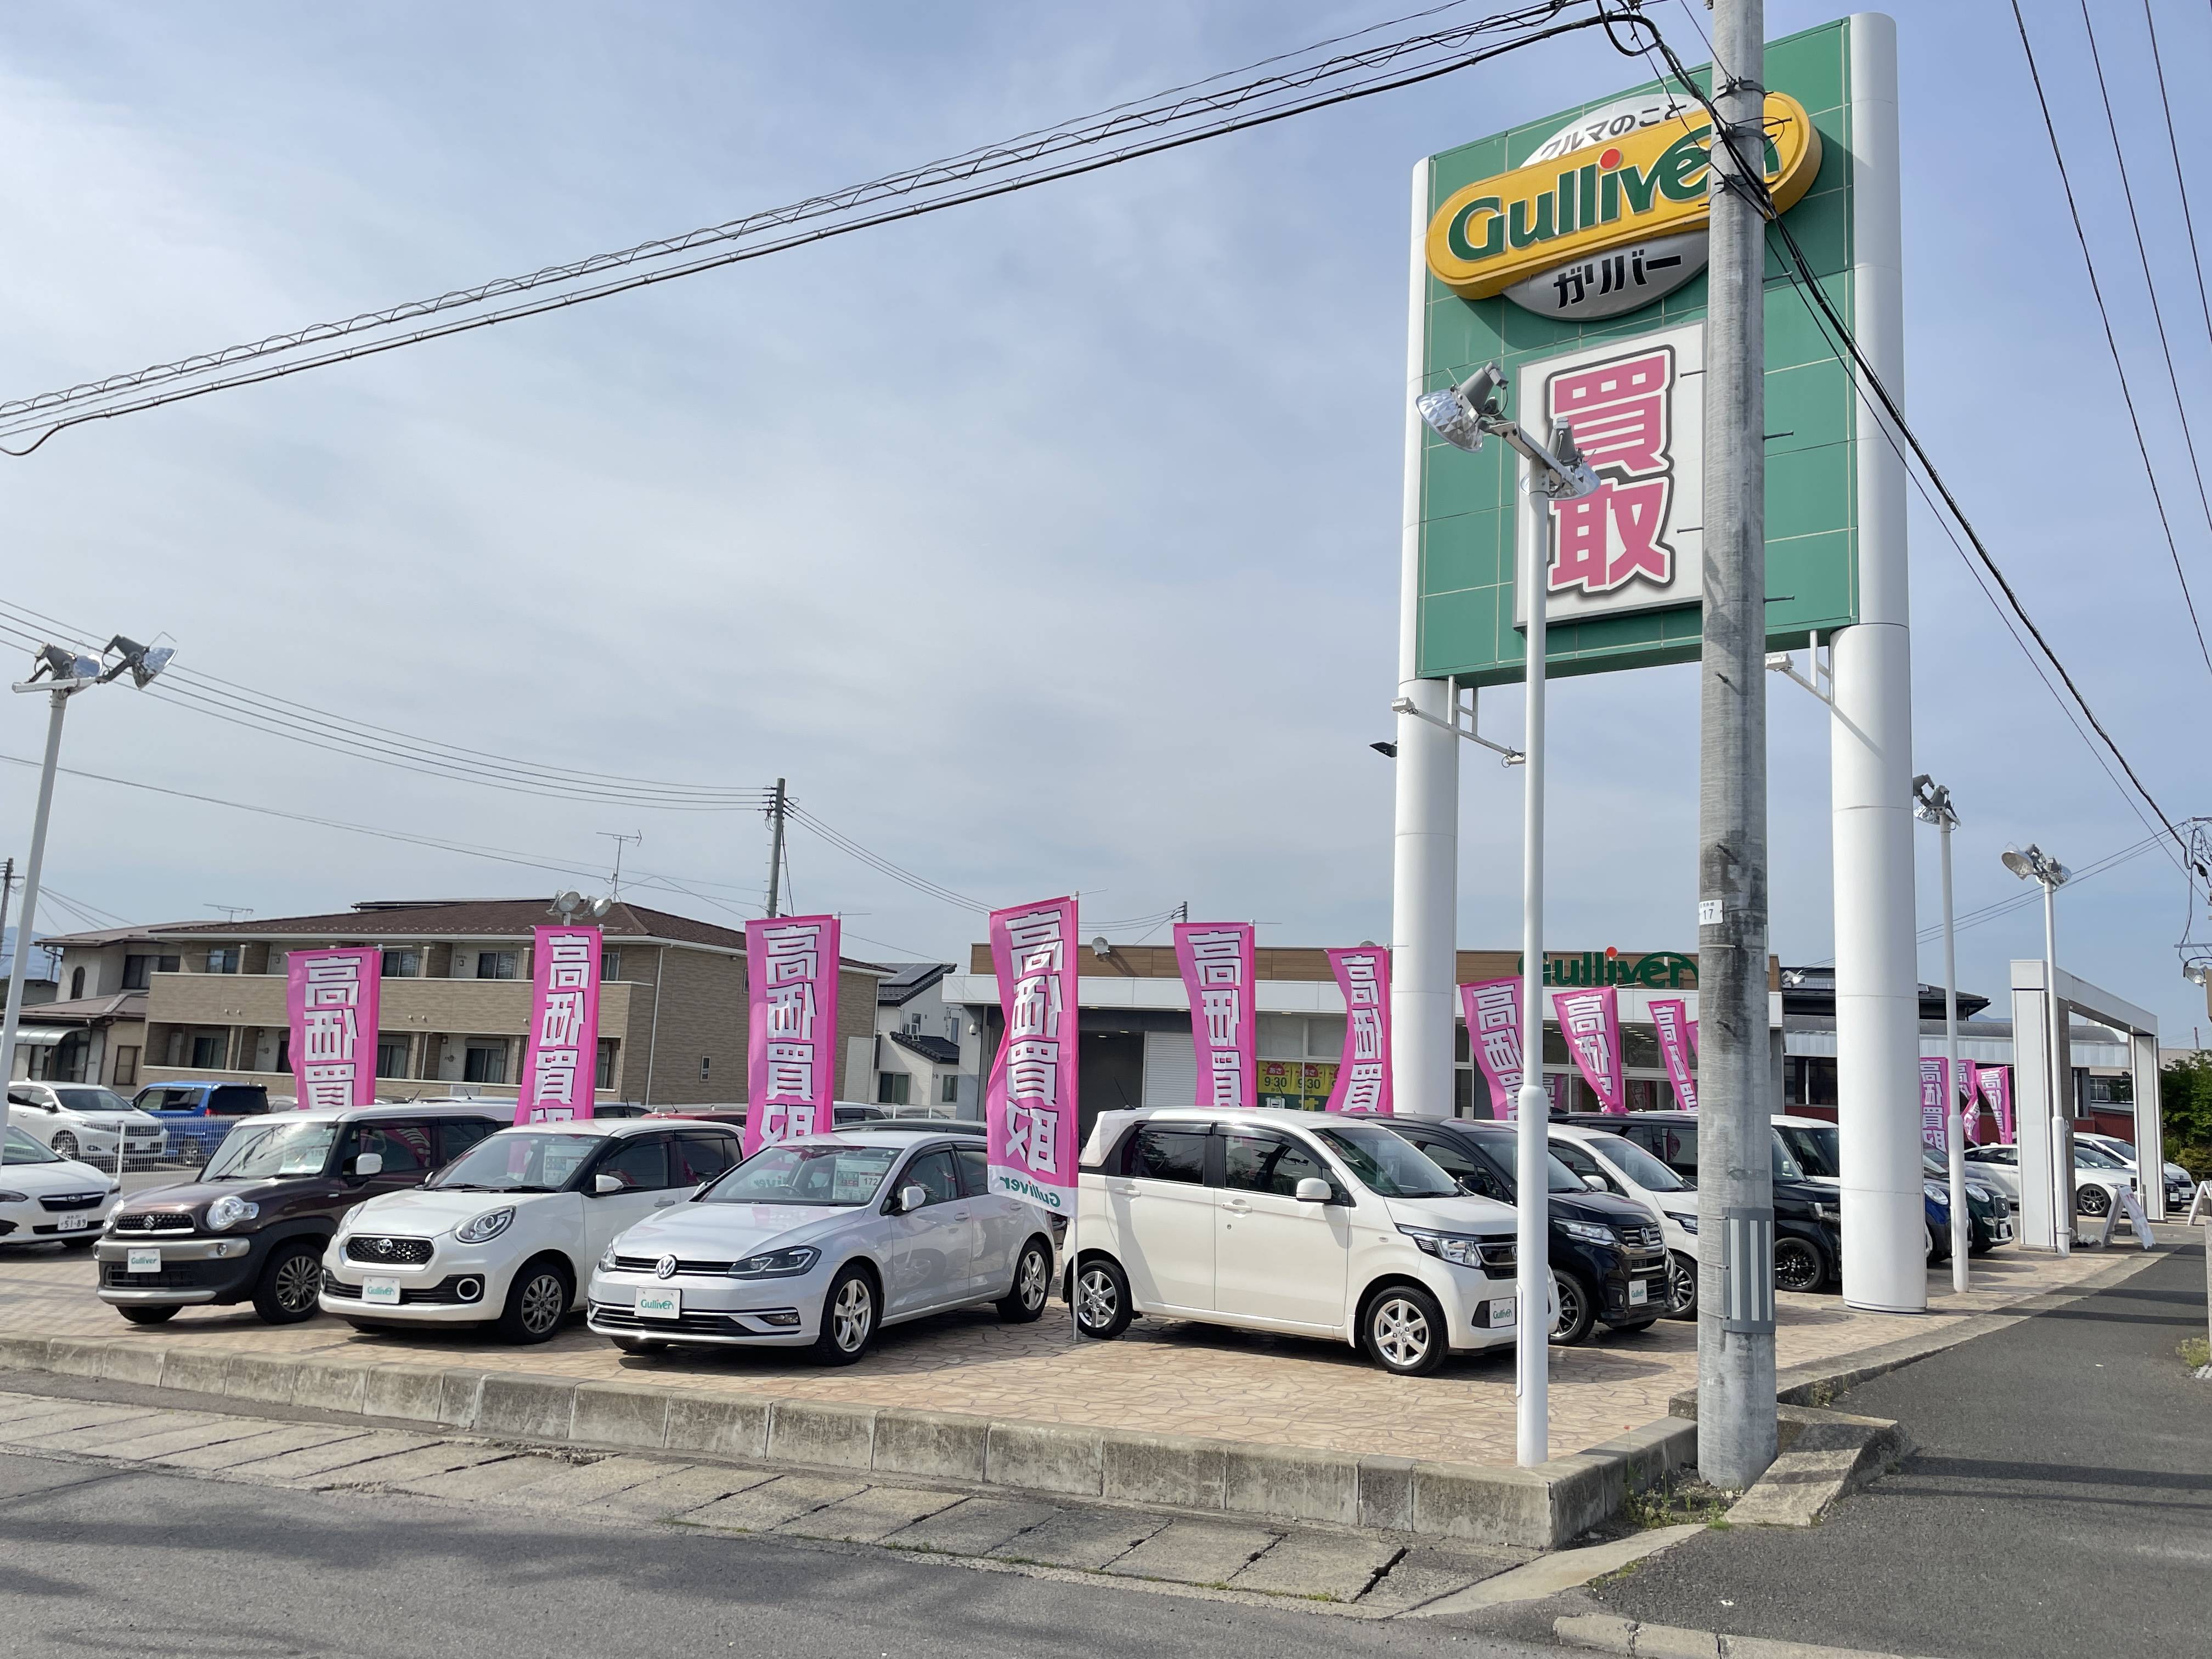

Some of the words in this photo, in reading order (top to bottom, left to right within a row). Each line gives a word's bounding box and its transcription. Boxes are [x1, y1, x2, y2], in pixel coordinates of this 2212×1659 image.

[1447, 122, 1782, 261] Gullive
[1553, 249, 1683, 309] ガリバー
[1547, 350, 1672, 592] 買取
[1703, 909, 1713, 920] 17
[1264, 1076, 1287, 1087] 9:30
[131, 1257, 158, 1265] Gulliver
[640, 1299, 674, 1310] Gulliver
[1493, 1307, 1513, 1320] Gulliver
